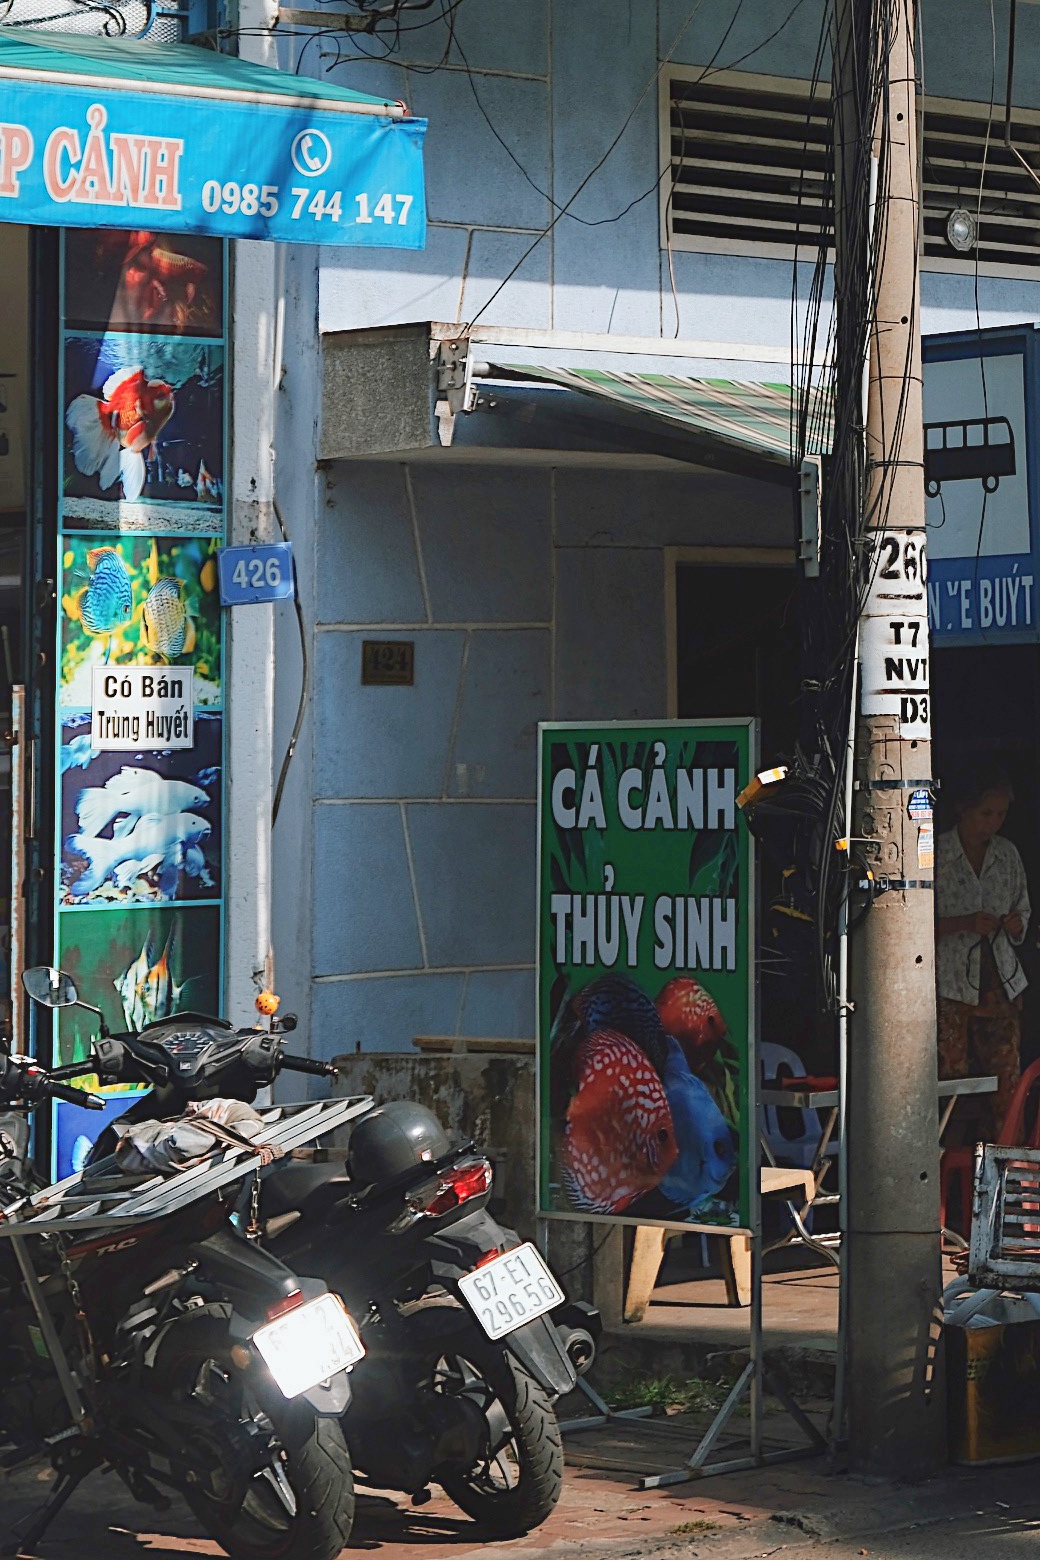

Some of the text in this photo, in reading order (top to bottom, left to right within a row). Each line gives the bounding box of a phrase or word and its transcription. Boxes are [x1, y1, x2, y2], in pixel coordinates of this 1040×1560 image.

[43, 103, 185, 210] CẢNH
[201, 180, 279, 217] 0985
[291, 188, 342, 222] 744
[355, 193, 413, 225] 147
[232, 558, 281, 588] 426
[979, 562, 1034, 628] BUÝT
[104, 674, 183, 698] Có Bán
[900, 696, 928, 723] D3
[97, 704, 188, 742] Trùng Huyết
[551, 741, 736, 830] CÁ CẢNH
[550, 864, 736, 971] THỦY SINH
[473, 1255, 531, 1301] 67-E1
[482, 1277, 555, 1333] 296.56
